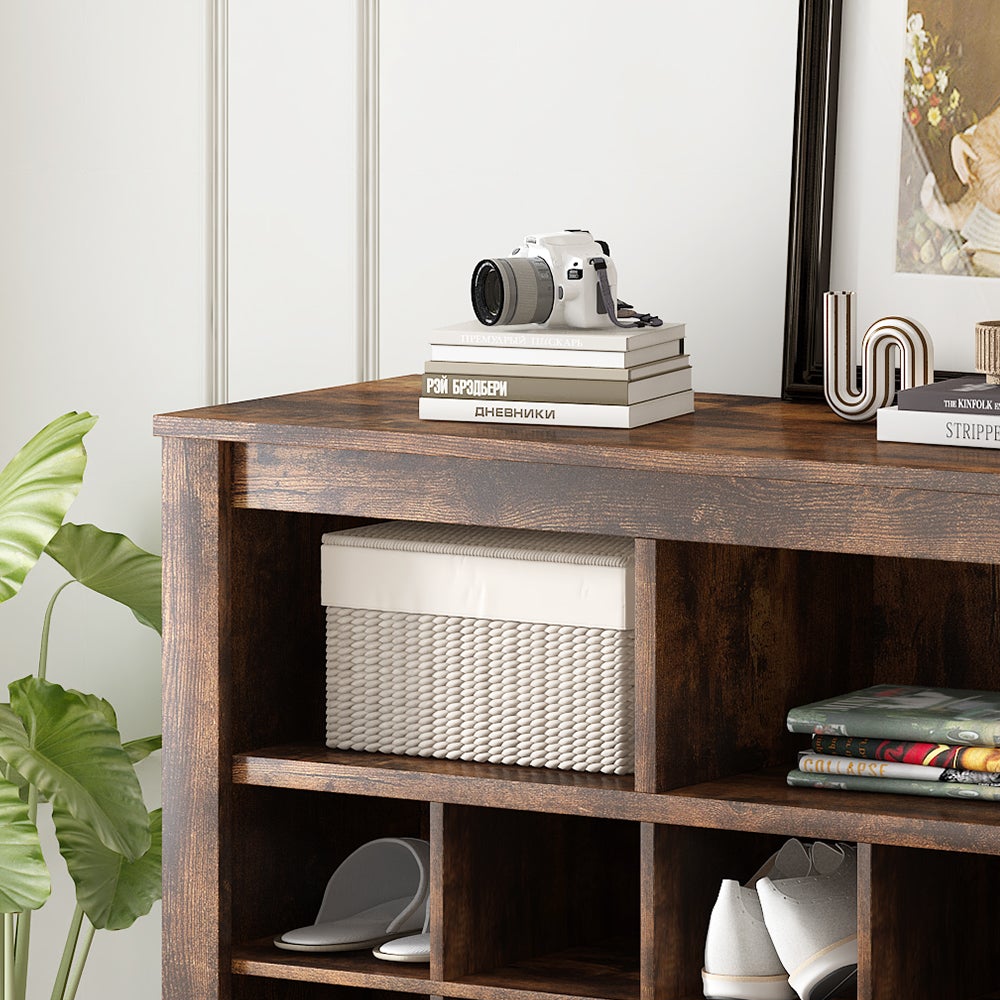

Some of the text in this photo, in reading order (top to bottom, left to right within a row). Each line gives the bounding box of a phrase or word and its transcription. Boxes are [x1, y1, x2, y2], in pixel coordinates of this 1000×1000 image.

[426, 375, 508, 397] РЭЙ БРЭДБЕРИ
[943, 400, 957, 408] THE
[957, 398, 993, 410] KINFOLK
[474, 406, 556, 419] ДНЕВНИКИ
